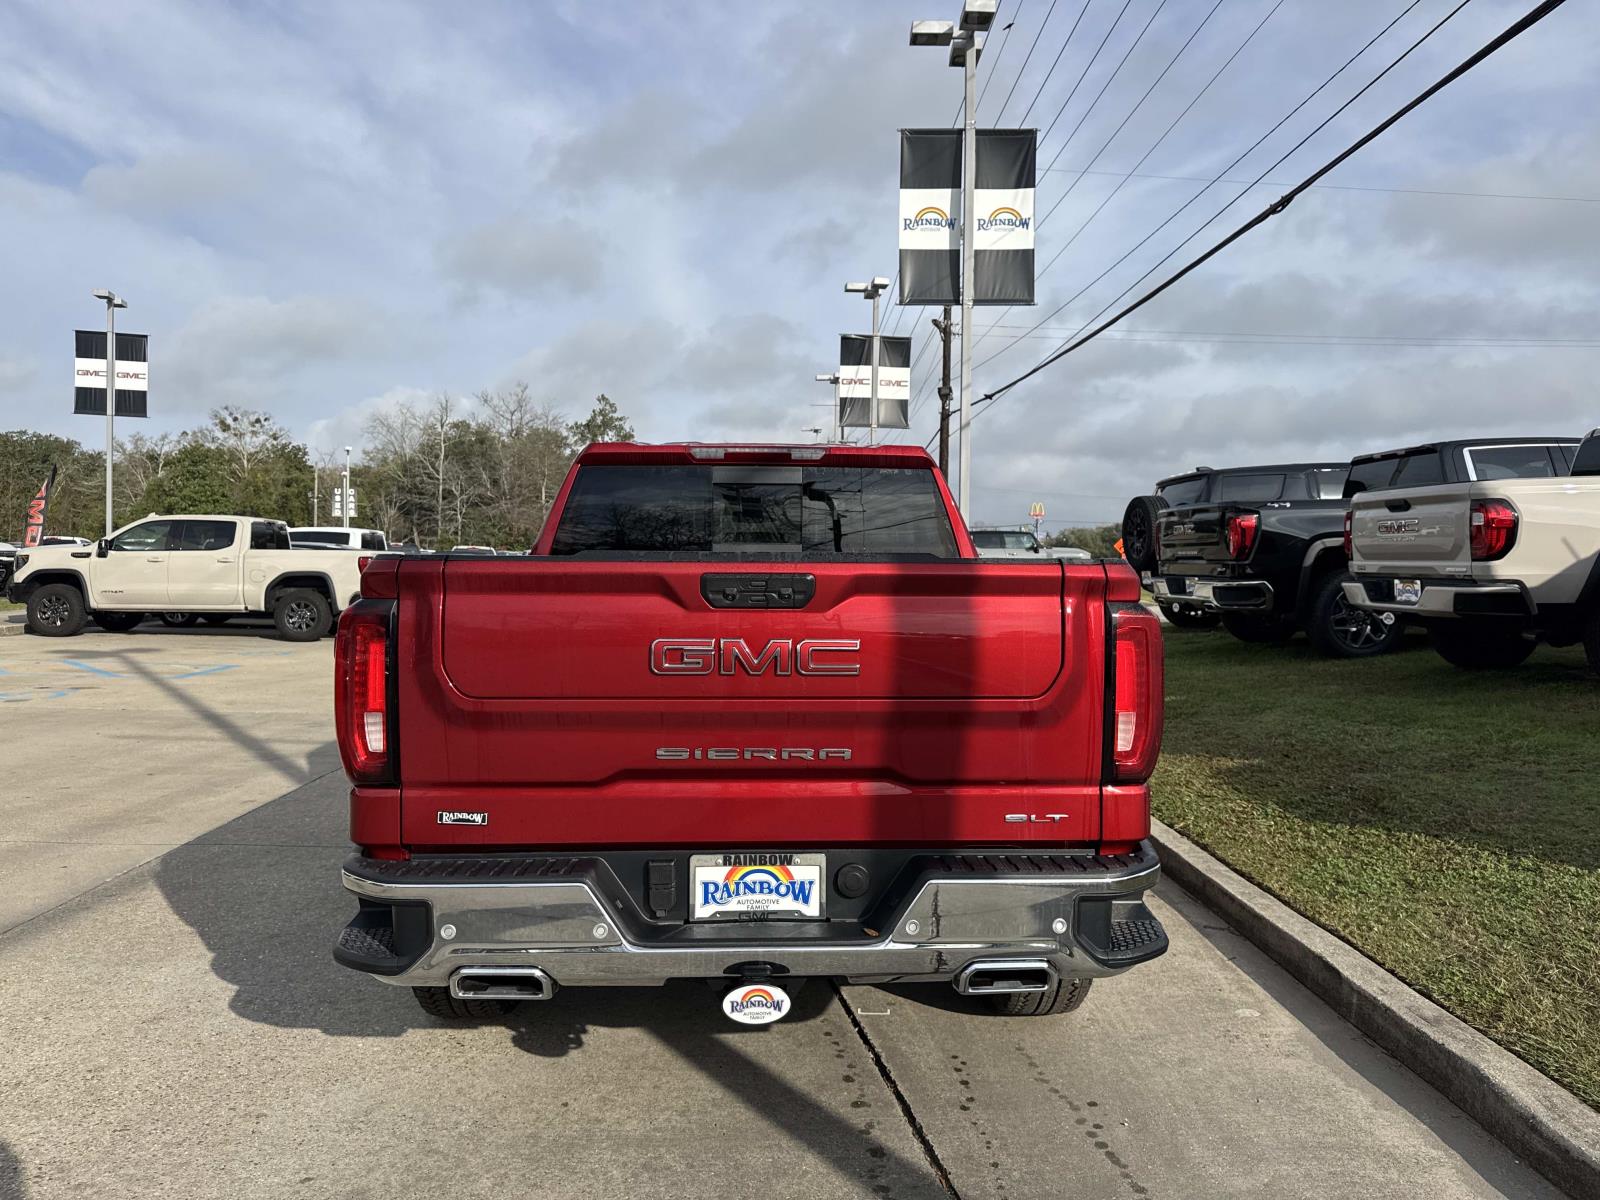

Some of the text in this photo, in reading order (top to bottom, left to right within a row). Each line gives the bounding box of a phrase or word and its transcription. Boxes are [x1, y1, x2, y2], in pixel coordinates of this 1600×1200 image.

[904, 217, 957, 232] RAINBOW
[977, 217, 1031, 232] RAINBOW
[77, 369, 108, 377] GMC
[116, 371, 147, 380] GMC
[841, 378, 871, 386] GMC
[879, 379, 909, 387] GMC
[1377, 519, 1419, 534] GMC
[650, 638, 861, 676] GMC
[655, 747, 852, 761] SIERRA
[442, 811, 484, 825] RAINBOW
[1004, 813, 1069, 823] SLT
[723, 854, 794, 866] RAINBOW
[701, 879, 817, 908] RAINBOW
[738, 912, 778, 922] GMC
[730, 999, 785, 1015] RAINBOW
